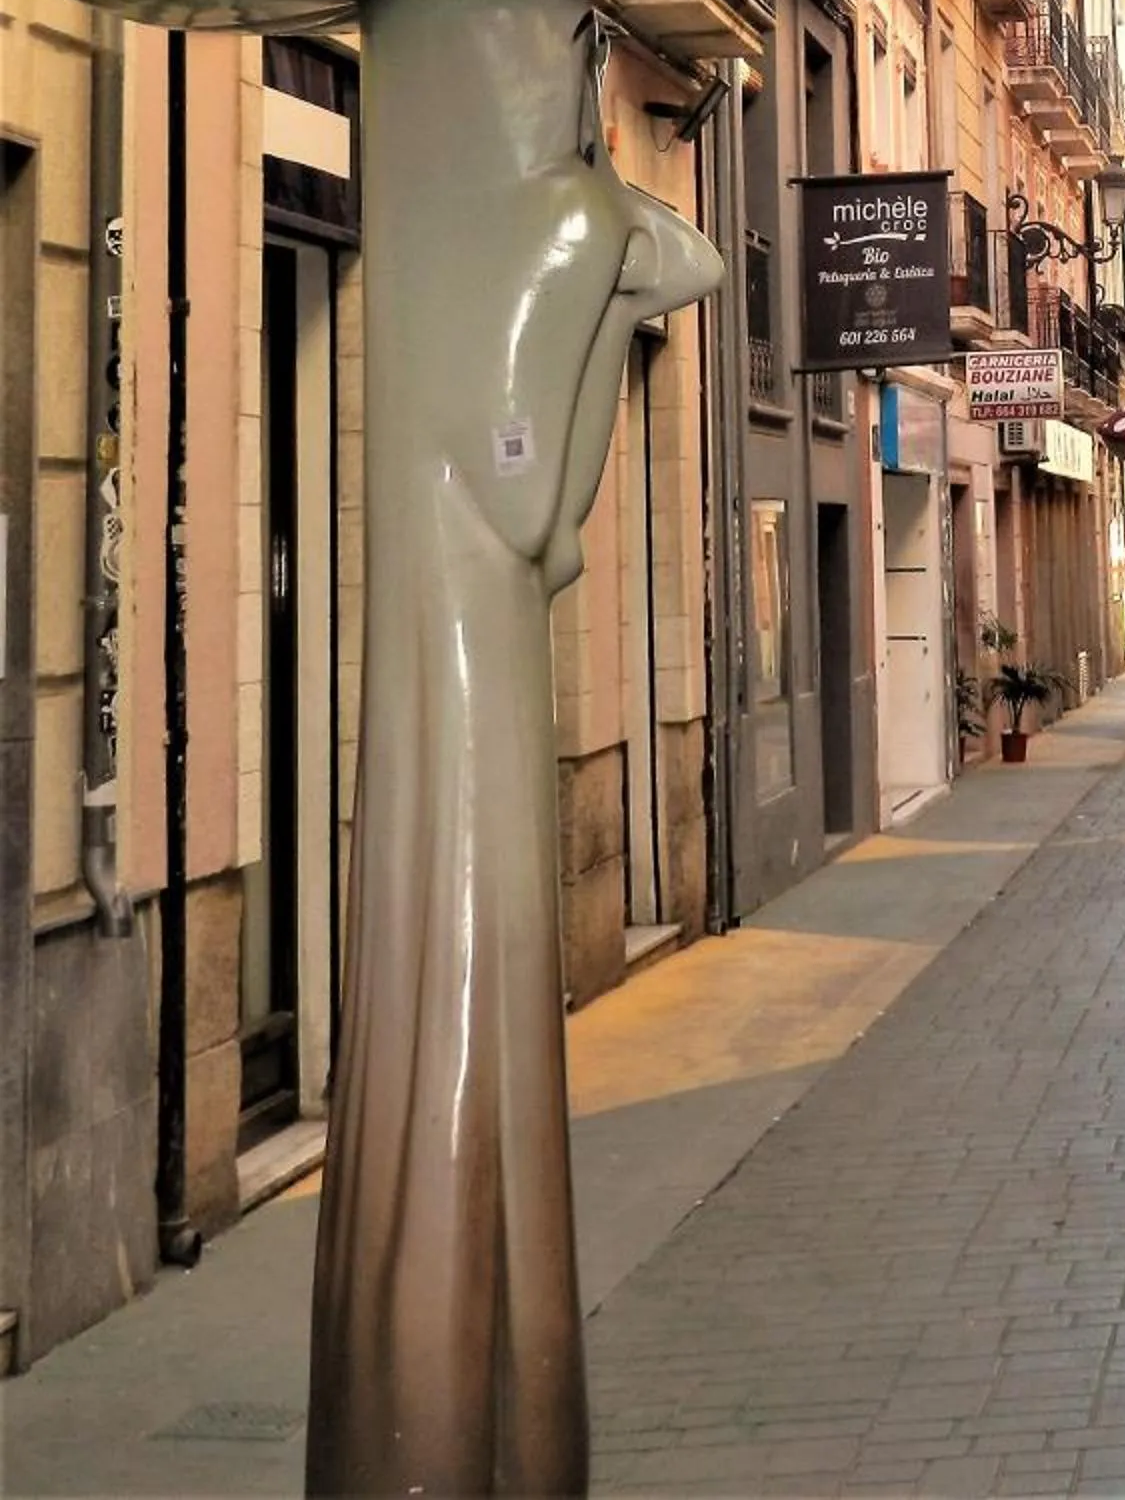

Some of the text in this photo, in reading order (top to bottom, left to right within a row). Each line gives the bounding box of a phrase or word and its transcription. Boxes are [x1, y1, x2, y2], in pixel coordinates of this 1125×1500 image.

[833, 196, 928, 223] michèle
[881, 219, 927, 232] croc
[862, 246, 890, 265] Bio
[879, 267, 891, 279] &
[839, 331, 861, 346] 601
[969, 355, 1057, 368] CARNICERIA
[971, 368, 1054, 384] BOUZIANE
[971, 389, 1015, 403] Halal
